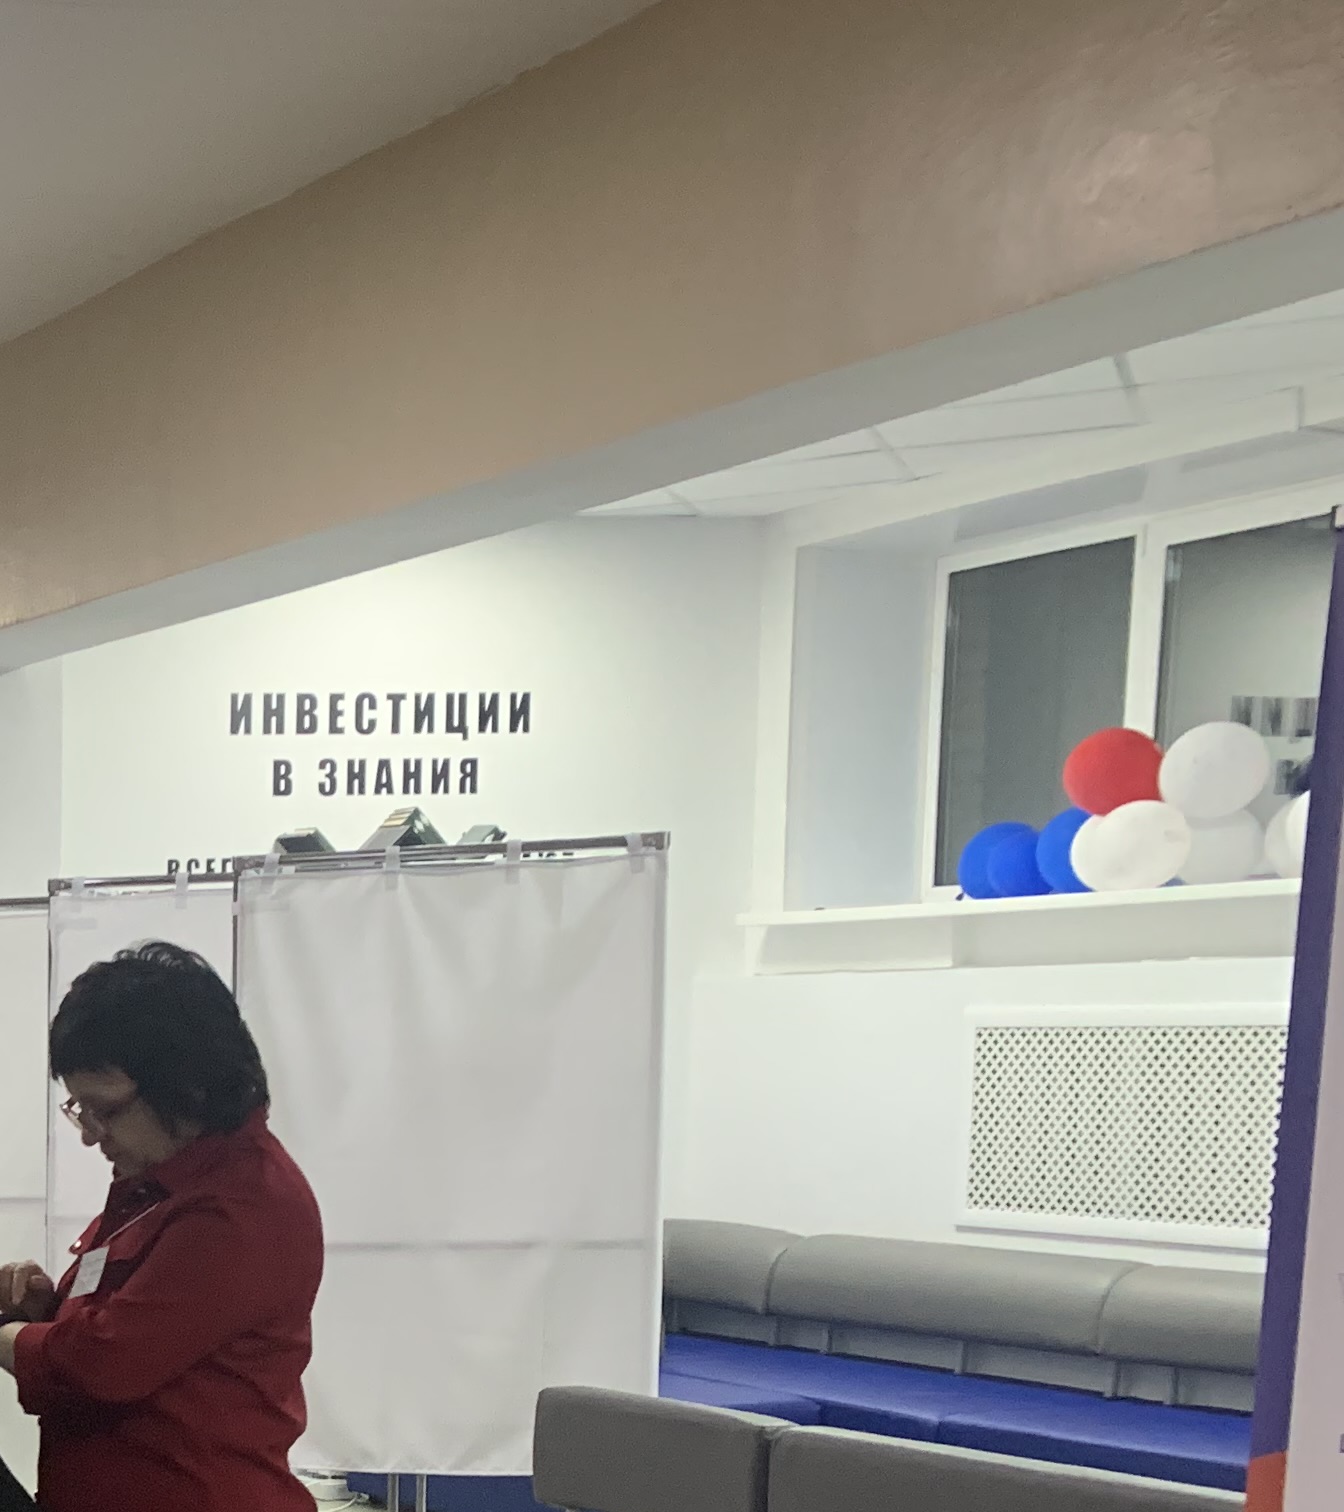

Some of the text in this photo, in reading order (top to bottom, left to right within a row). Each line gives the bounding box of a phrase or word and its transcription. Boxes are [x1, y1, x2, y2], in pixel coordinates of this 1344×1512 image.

[228, 691, 532, 741] ИНВЕСТИЦИИ
[272, 757, 479, 797] В ЗНАНИЯ
